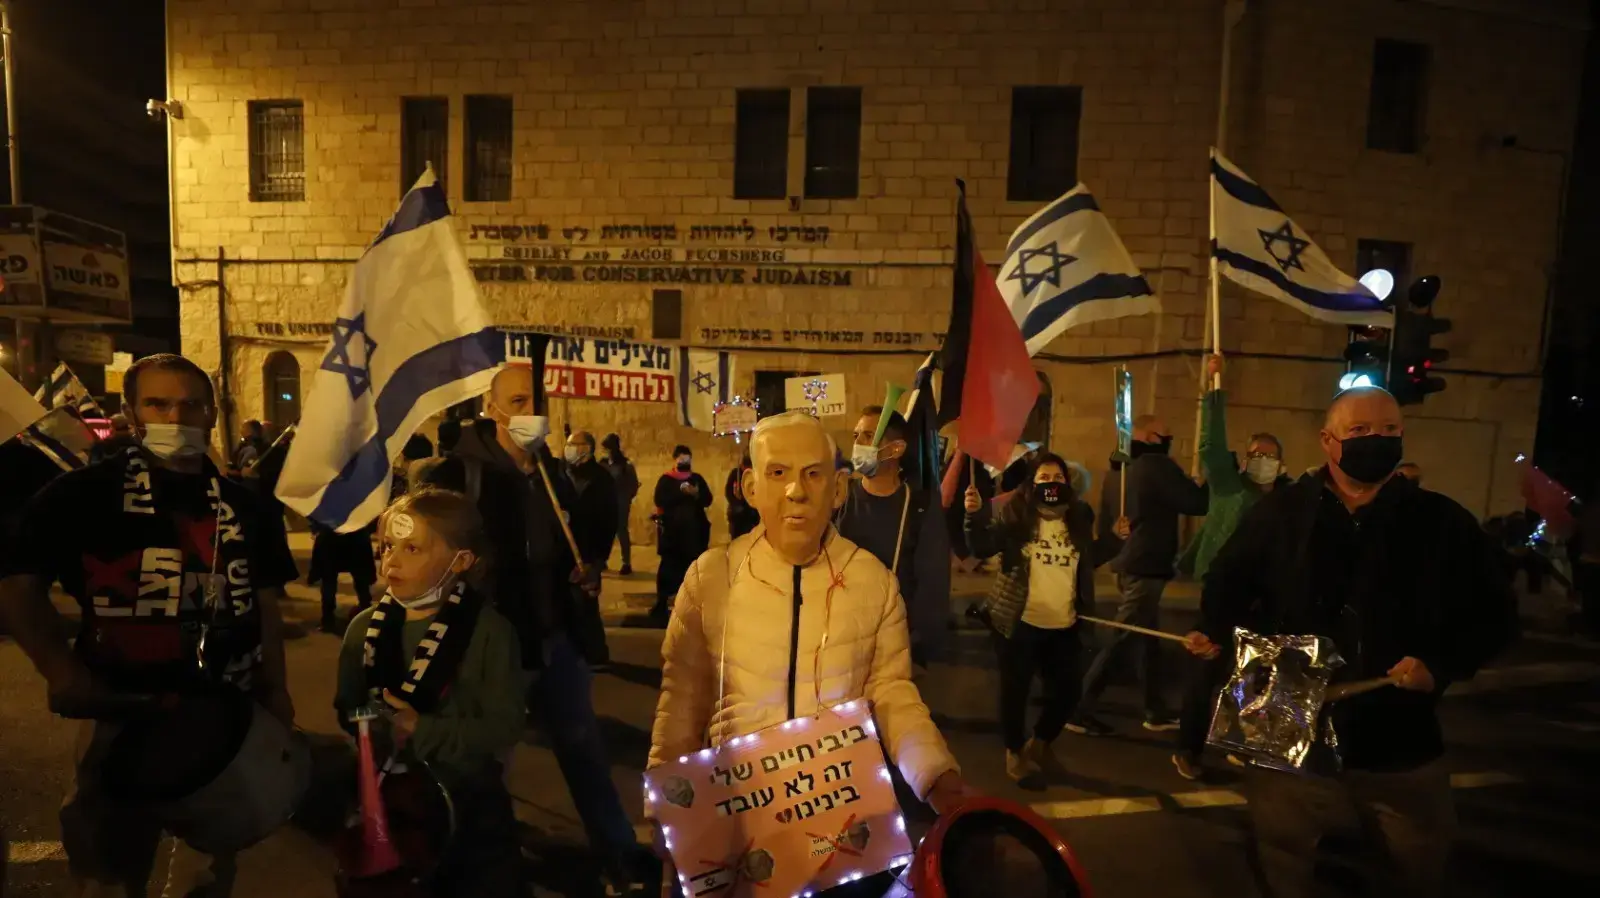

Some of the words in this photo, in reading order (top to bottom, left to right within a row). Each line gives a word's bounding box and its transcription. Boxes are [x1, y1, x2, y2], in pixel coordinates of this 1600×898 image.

[600, 224, 677, 240] מסורתית
[690, 218, 755, 241] ליהדות
[502, 246, 572, 260] SHIRLEY
[583, 250, 610, 261] AND
[621, 247, 673, 261] JACOB
[685, 248, 784, 263] FUCHSBERG
[53, 264, 120, 289] פאשה
[535, 265, 577, 281] FOR
[582, 265, 747, 284] CONSERVATIVE
[752, 266, 852, 286] JUDAISM
[287, 323, 335, 337] UNITE
[571, 326, 635, 339] JUDAISM
[551, 336, 584, 363] את
[594, 339, 671, 370] מצילים
[585, 372, 669, 401] נלחמים
[816, 725, 868, 753] ביבי
[760, 743, 815, 774] חיים
[709, 761, 753, 786] שלי
[824, 760, 853, 783] זה
[783, 771, 815, 798] לא
[715, 786, 775, 816] עובד
[794, 785, 861, 821] בינינו
